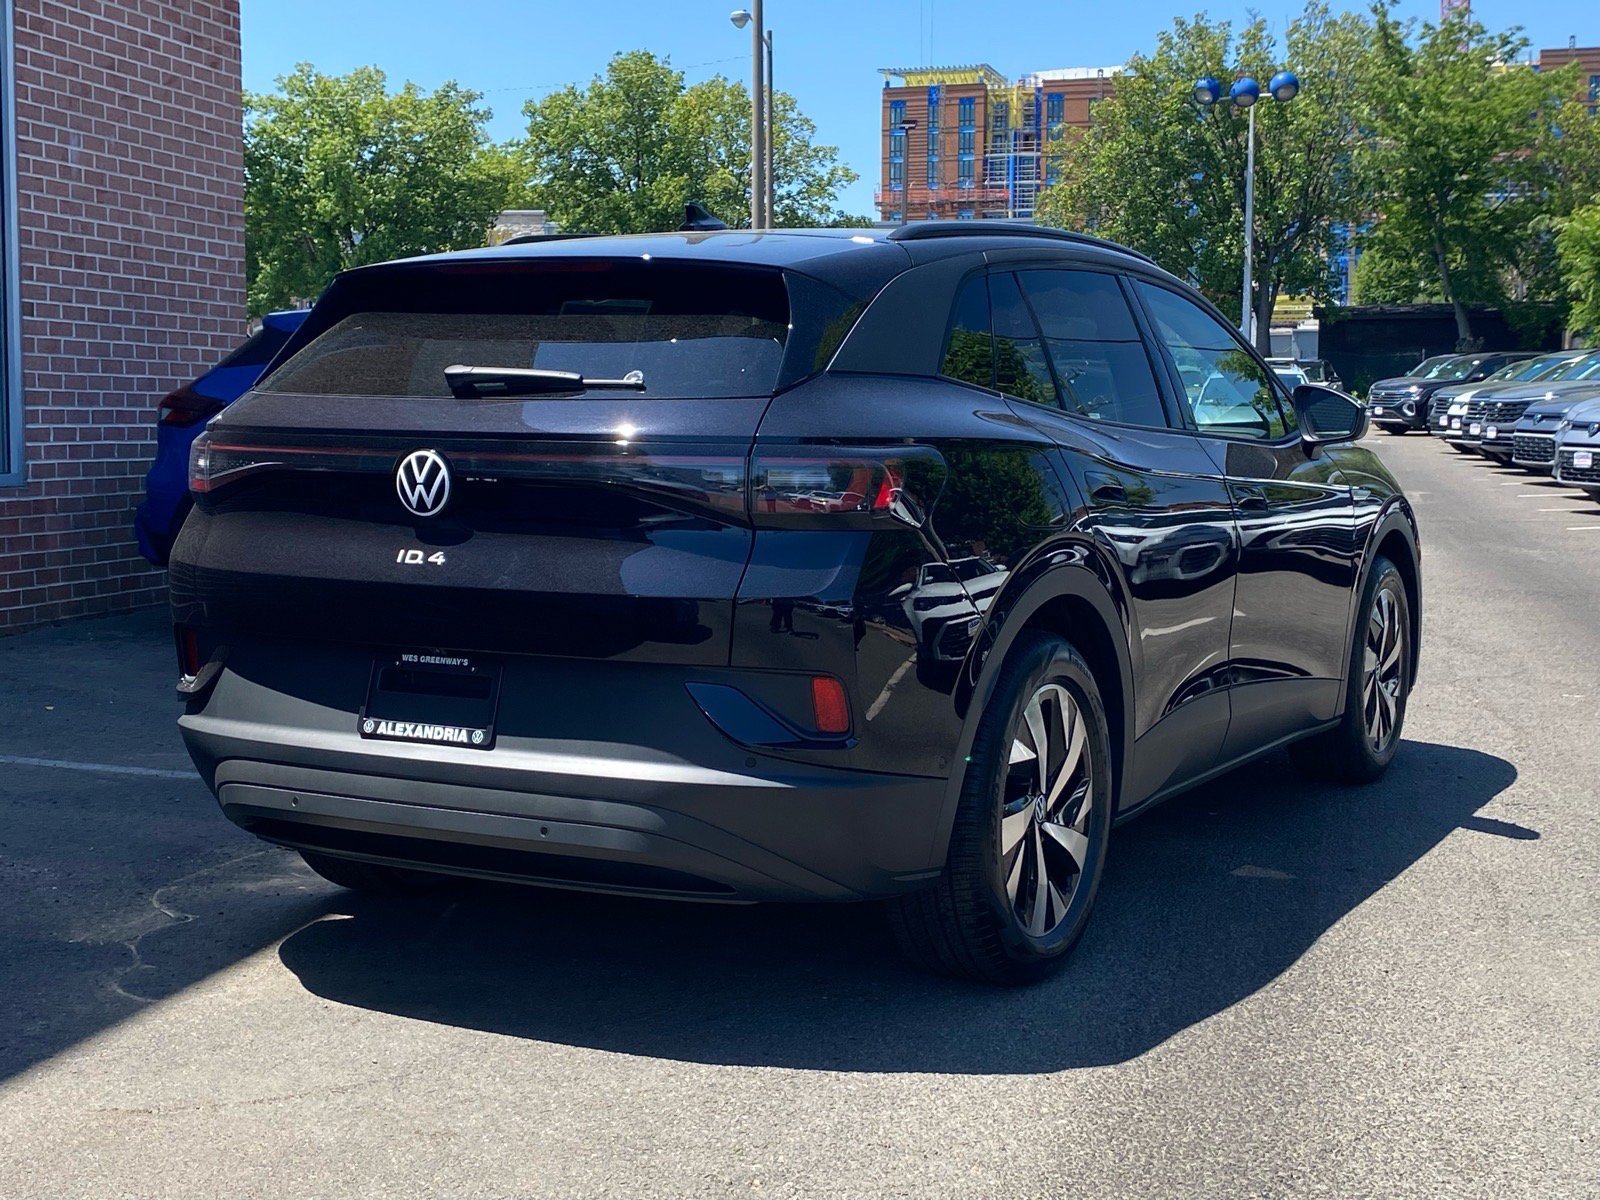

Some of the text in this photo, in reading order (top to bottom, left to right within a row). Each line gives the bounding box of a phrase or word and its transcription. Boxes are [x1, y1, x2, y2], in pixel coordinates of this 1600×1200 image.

[397, 450, 449, 516] VW
[402, 654, 469, 666] WES GREENWAY'S
[377, 721, 468, 743] ALEXANDRIA
